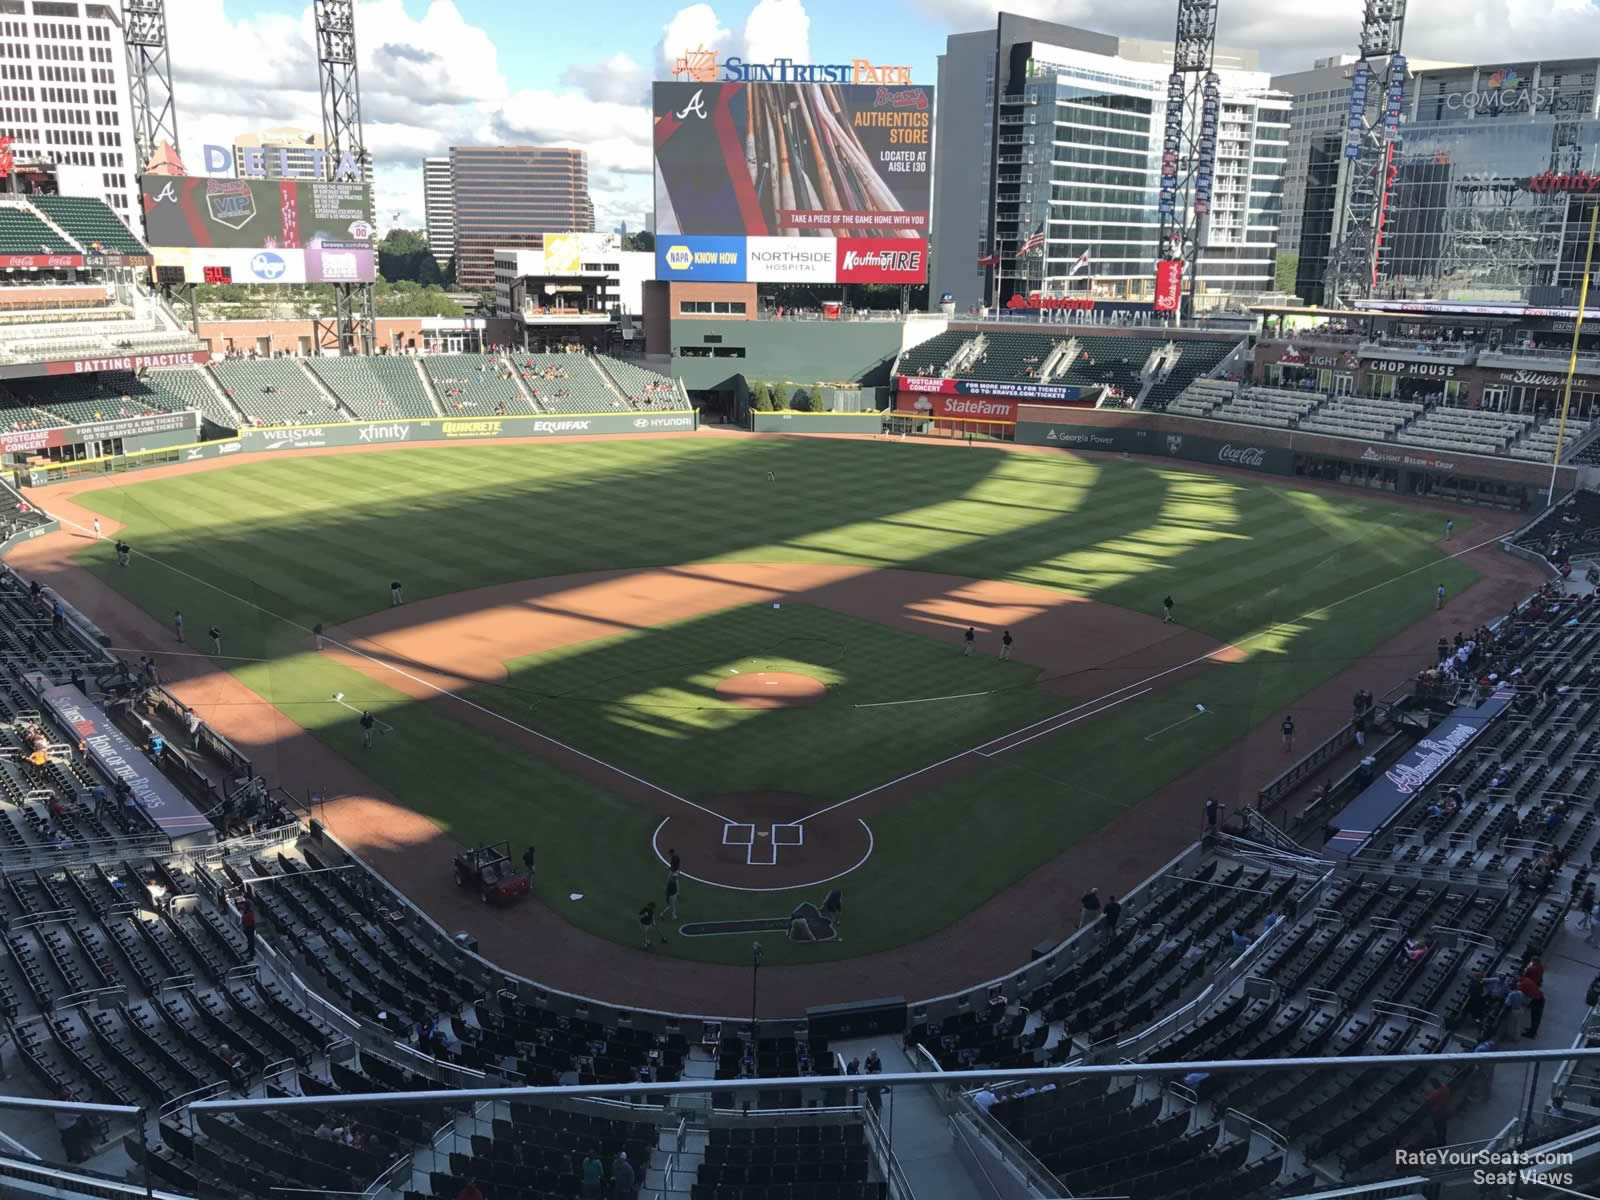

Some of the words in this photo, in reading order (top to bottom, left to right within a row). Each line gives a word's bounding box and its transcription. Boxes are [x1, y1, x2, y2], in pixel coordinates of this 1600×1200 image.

[852, 59, 912, 85] PARK
[1447, 87, 1560, 110] COMCAST
[854, 112, 928, 128] AUTHENTICS
[890, 129, 928, 144] STORE
[203, 144, 362, 180] DELTA
[880, 151, 915, 161] LOCATED
[916, 152, 926, 161] AT
[888, 162, 910, 172] AISLE
[912, 162, 926, 172] 130
[213, 195, 249, 214] VIP
[792, 215, 807, 223] TAKE
[808, 215, 813, 223] A
[814, 215, 832, 223] PIECE
[833, 215, 840, 224] OF
[842, 216, 854, 224] THE
[855, 216, 872, 224] GAME
[874, 216, 892, 224] HOME
[894, 216, 910, 224] WITH
[911, 216, 924, 225] YOU
[86, 256, 104, 265] 6:42
[670, 252, 689, 263] NAPA
[694, 252, 718, 264] KNOW
[719, 252, 738, 264] HOW
[751, 251, 832, 262] NORTHSIDE
[842, 251, 893, 270] Kauffman
[880, 251, 921, 271] TIRE
[765, 263, 817, 271] HOSPITAL
[1076, 309, 1105, 325] BALL
[74, 358, 131, 373] BATTING
[136, 352, 194, 368] PRACTICE
[1310, 355, 1338, 367] LIGHT
[1371, 360, 1405, 372] CHOP
[1410, 363, 1454, 377] HOUSE
[907, 378, 943, 386] POSTGAME
[1500, 372, 1513, 381] THE
[1513, 369, 1559, 386] Silver
[992, 389, 1065, 399] BRAVES.COM/TICKETS
[93, 425, 114, 433] MORE
[116, 422, 133, 430] INFO
[156, 416, 184, 424] TICKETS
[108, 422, 184, 438] BRAVES.COM/TICKETS
[442, 421, 503, 433] QUIKRETE
[533, 420, 590, 433] EQUIFAX
[651, 418, 692, 427] HYUNDAI
[1, 431, 48, 445] POSTGAME
[263, 428, 323, 440] WELLSTAR
[359, 423, 410, 442] xfinity
[1059, 432, 1088, 443] Georgia
[1091, 434, 1114, 444] Power
[5, 439, 47, 452] CONCERT
[1218, 444, 1265, 466] Coca-Cola
[86, 735, 117, 758] HOME
[1417, 722, 1478, 757] Braves
[105, 753, 125, 767] OF
[114, 762, 139, 781] THE
[127, 776, 166, 810] BRAVES
